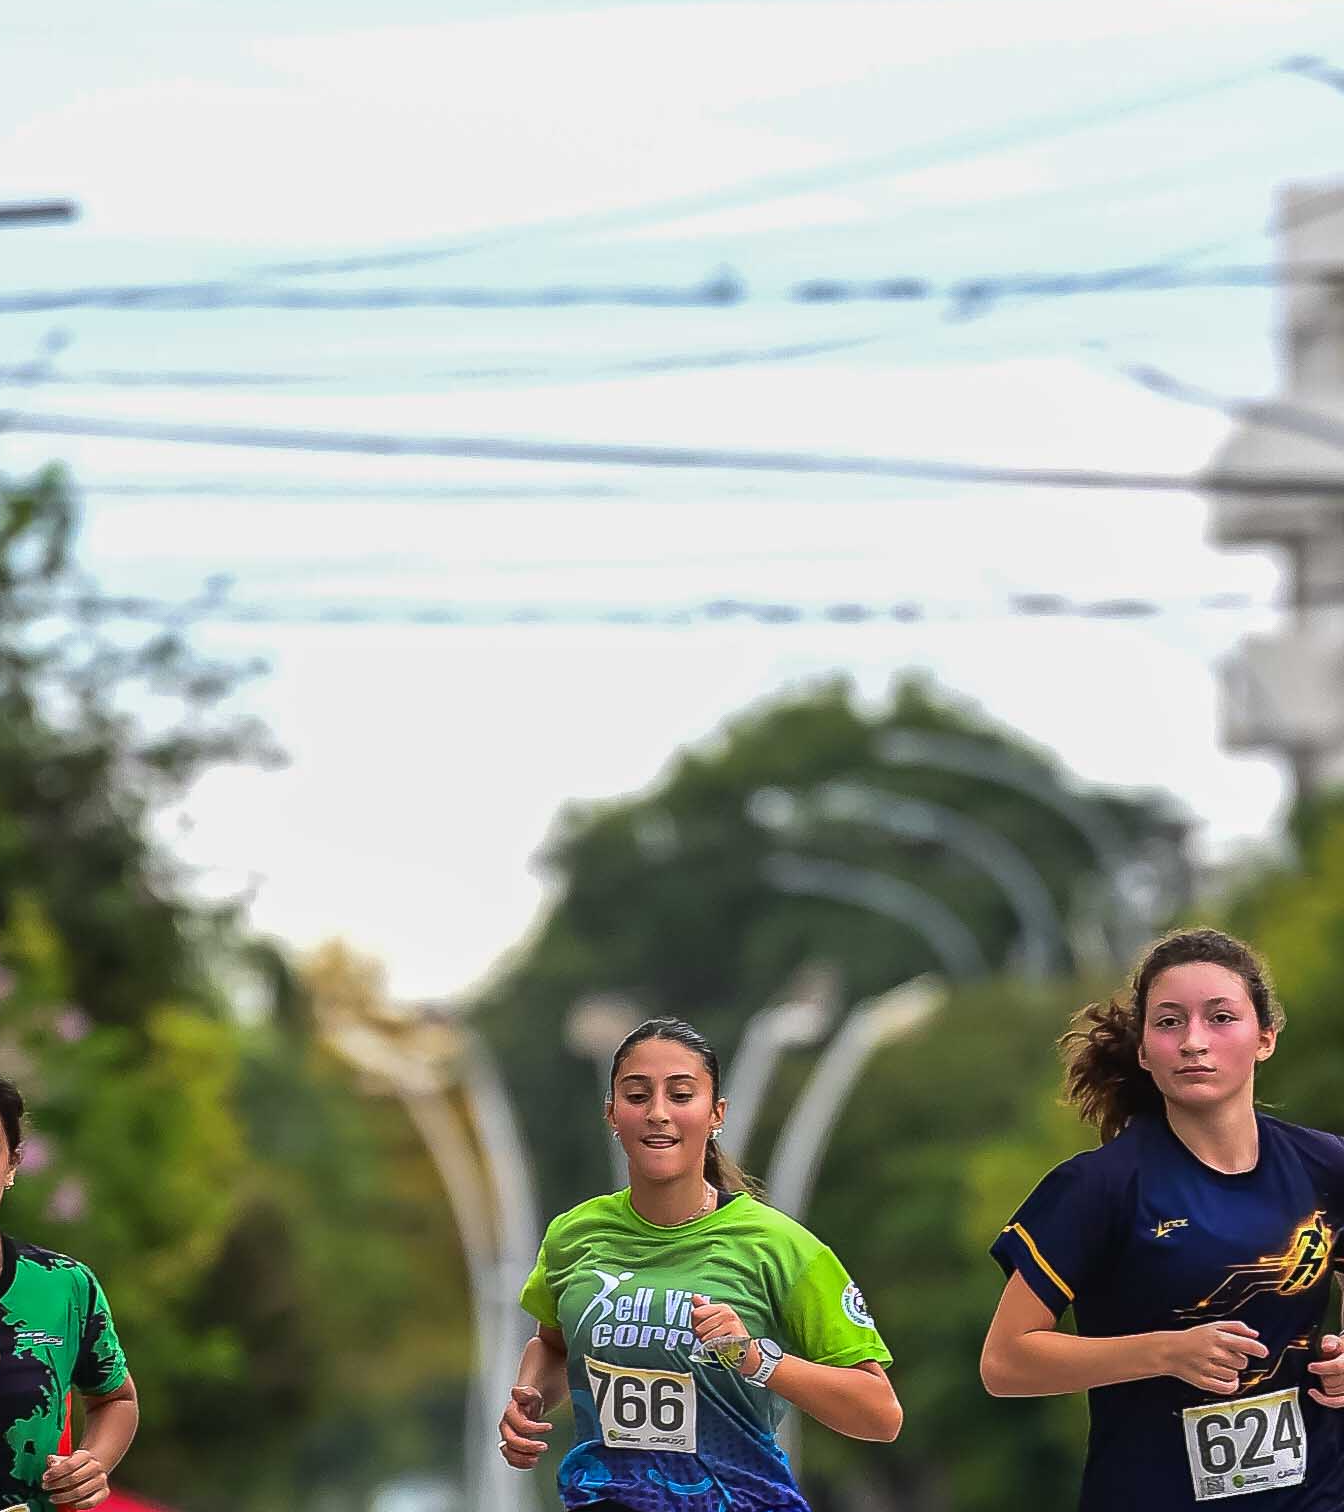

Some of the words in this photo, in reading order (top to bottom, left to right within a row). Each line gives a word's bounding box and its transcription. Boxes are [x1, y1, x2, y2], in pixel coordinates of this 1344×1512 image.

[592, 1323, 702, 1352] corr
[588, 1368, 684, 1432] 766
[1197, 1400, 1301, 1475] 624
